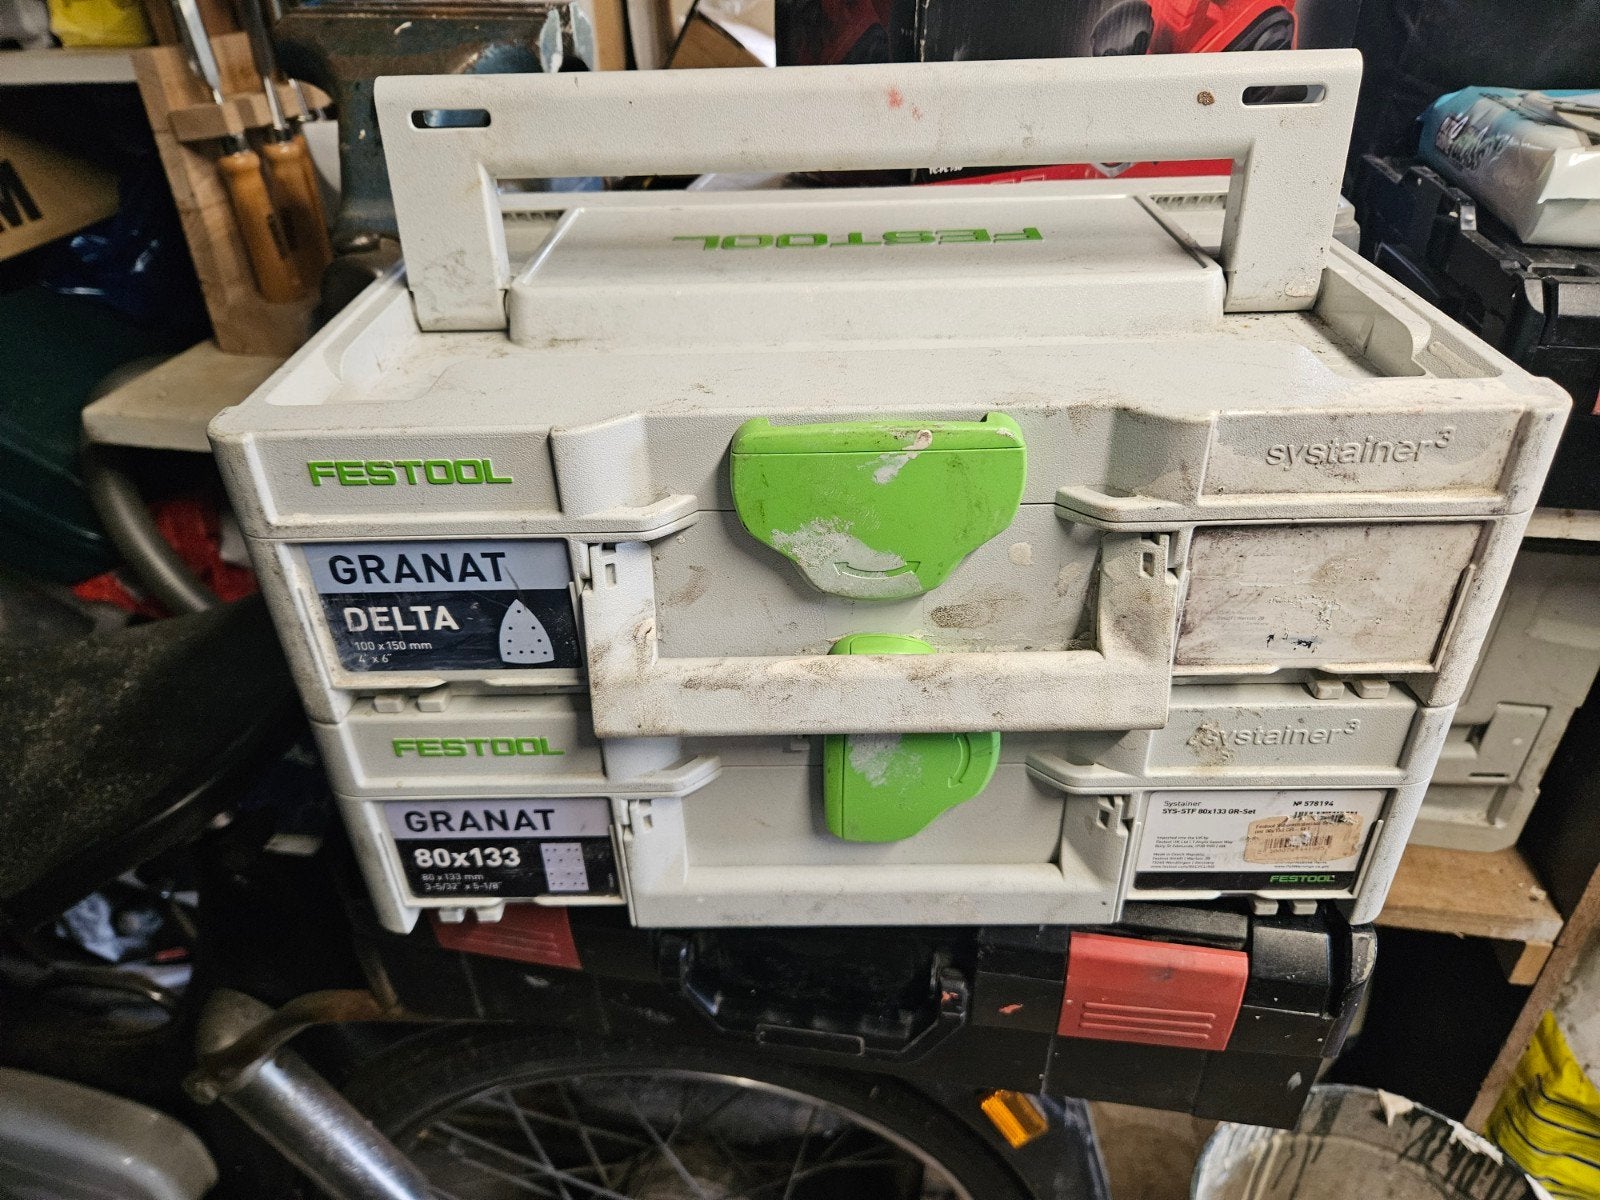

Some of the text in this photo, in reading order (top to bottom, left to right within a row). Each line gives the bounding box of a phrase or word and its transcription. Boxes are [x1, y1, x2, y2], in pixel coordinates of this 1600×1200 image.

[672, 227, 1043, 250] FESTOOL
[307, 459, 513, 486] FESTOOL
[328, 552, 505, 585] GRANAT
[343, 605, 460, 632] DELTA
[354, 641, 375, 651] 100
[387, 641, 406, 650] 150
[409, 642, 433, 650] mm
[372, 656, 379, 664] x
[391, 737, 566, 757] FESTOOL
[404, 809, 555, 832] GRANAT
[414, 847, 521, 868] 80x133
[422, 873, 434, 881] 80
[444, 873, 461, 881] 133
[1269, 875, 1335, 883] FESTOOL
